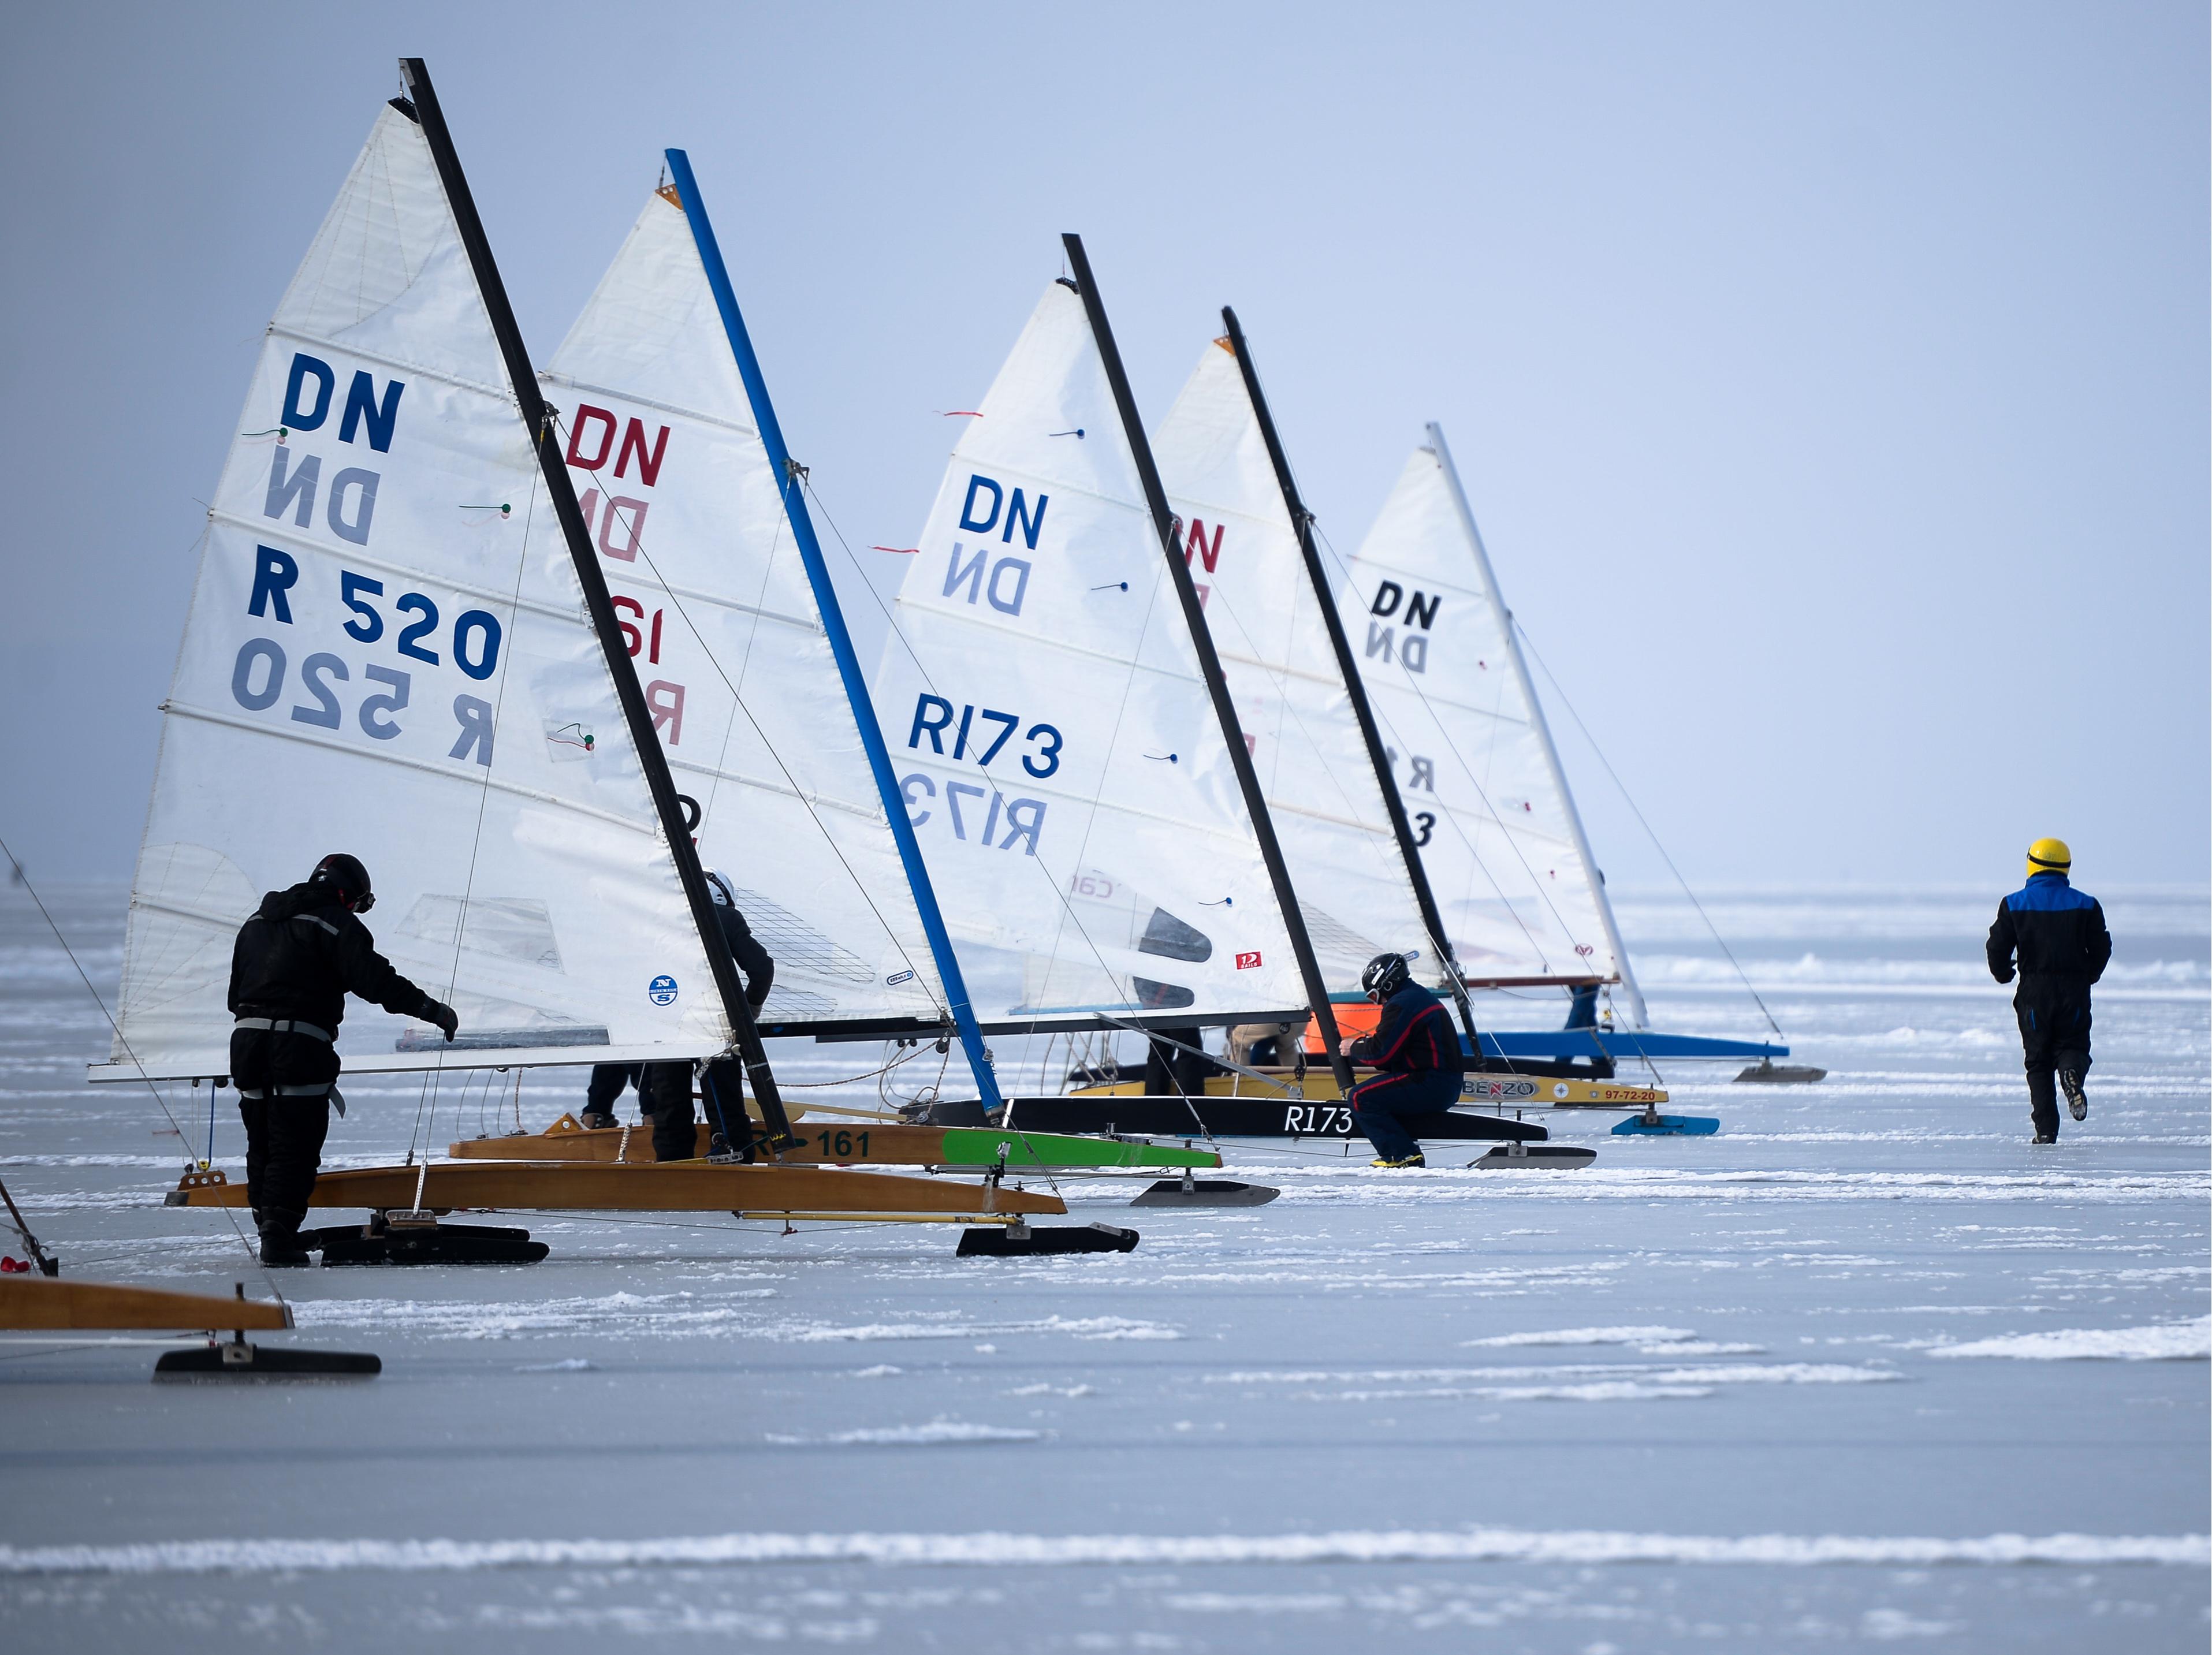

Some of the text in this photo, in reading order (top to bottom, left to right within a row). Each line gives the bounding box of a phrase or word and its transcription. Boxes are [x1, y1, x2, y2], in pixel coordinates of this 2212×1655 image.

[281, 352, 405, 453] DN
[566, 404, 671, 487] DN
[959, 474, 1049, 550] DN
[1175, 513, 1226, 573] N
[248, 544, 502, 680] R 520
[1371, 579, 1442, 631] DN
[908, 693, 1063, 778] R173
[656, 979, 671, 987] N
[657, 994, 670, 1002] S
[1462, 1080, 1536, 1099] BENZO
[1605, 1090, 1656, 1101] 97-72-20
[817, 1130, 869, 1157] 161
[1284, 1106, 1352, 1133] R173
